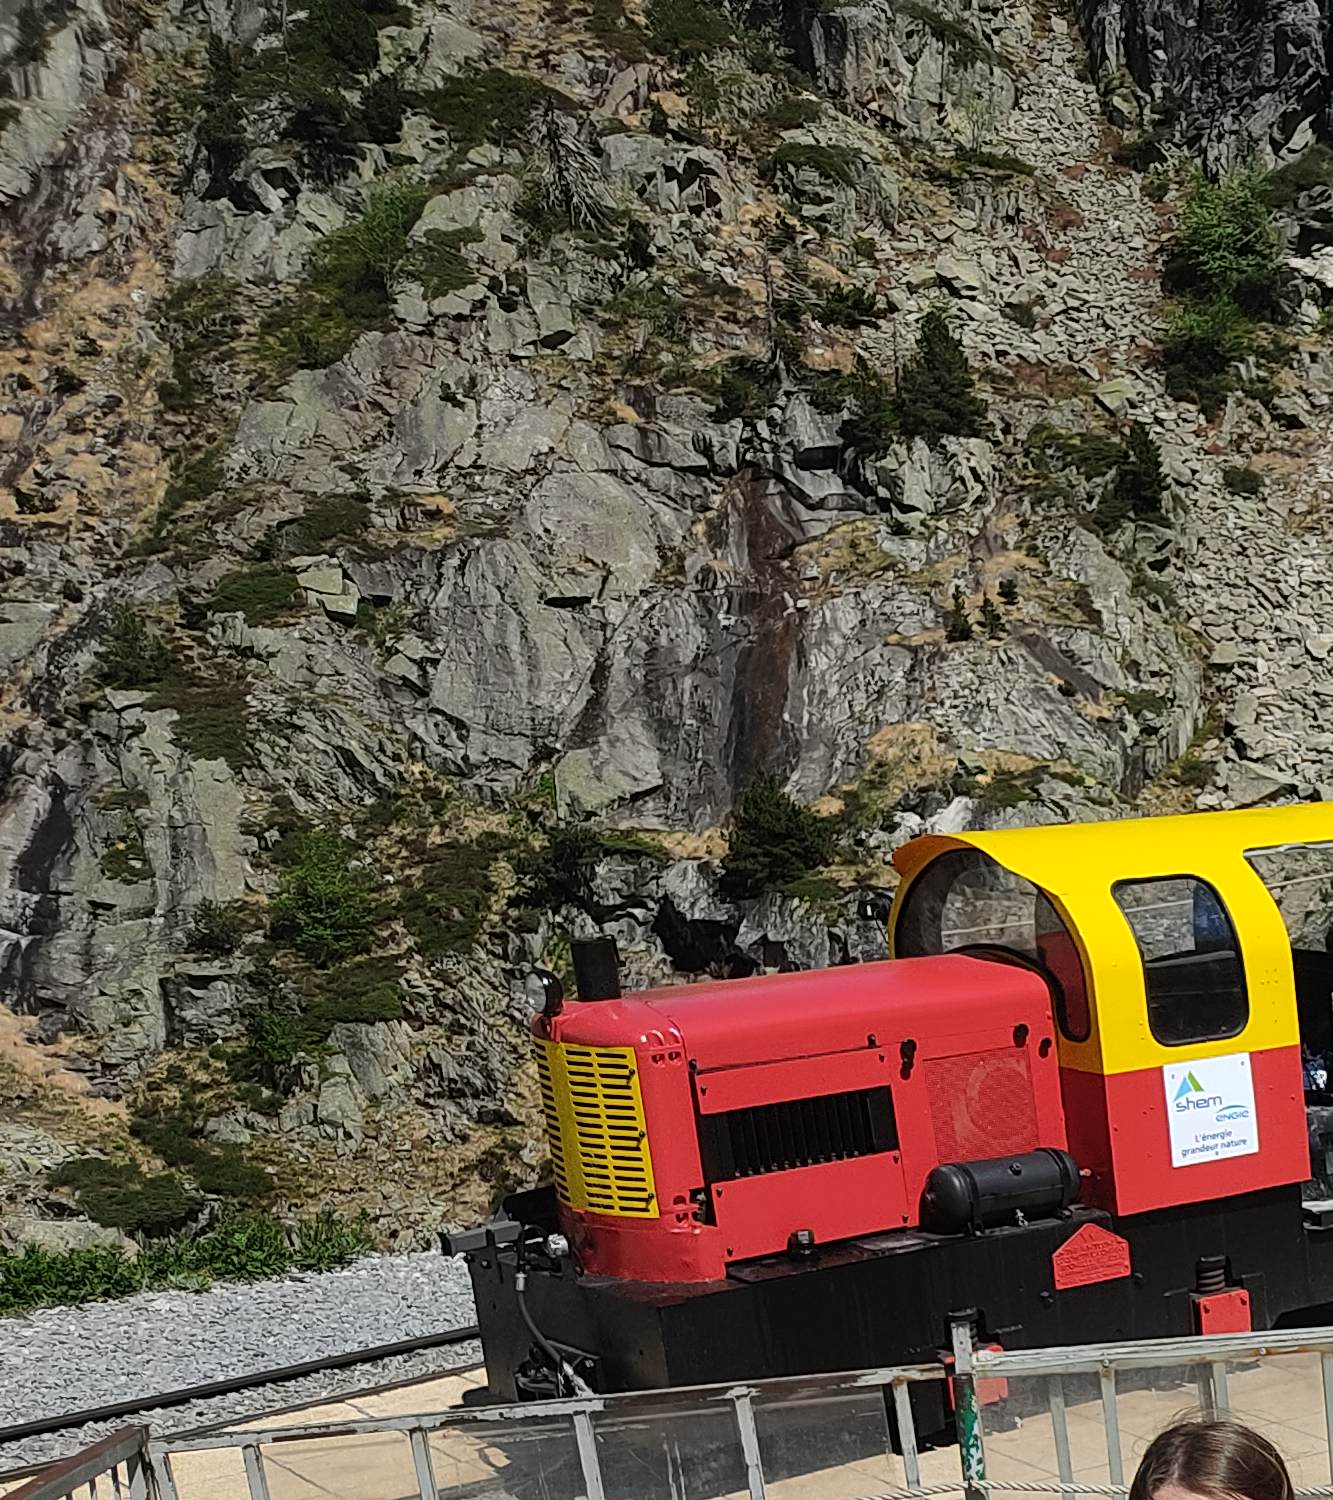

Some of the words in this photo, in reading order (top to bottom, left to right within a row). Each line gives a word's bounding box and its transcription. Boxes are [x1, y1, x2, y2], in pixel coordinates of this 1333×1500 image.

[1176, 1096, 1222, 1112] shem
[1195, 1129, 1232, 1142] L'énergie
[1181, 1144, 1219, 1158] grandeur
[1221, 1139, 1247, 1149] nature
